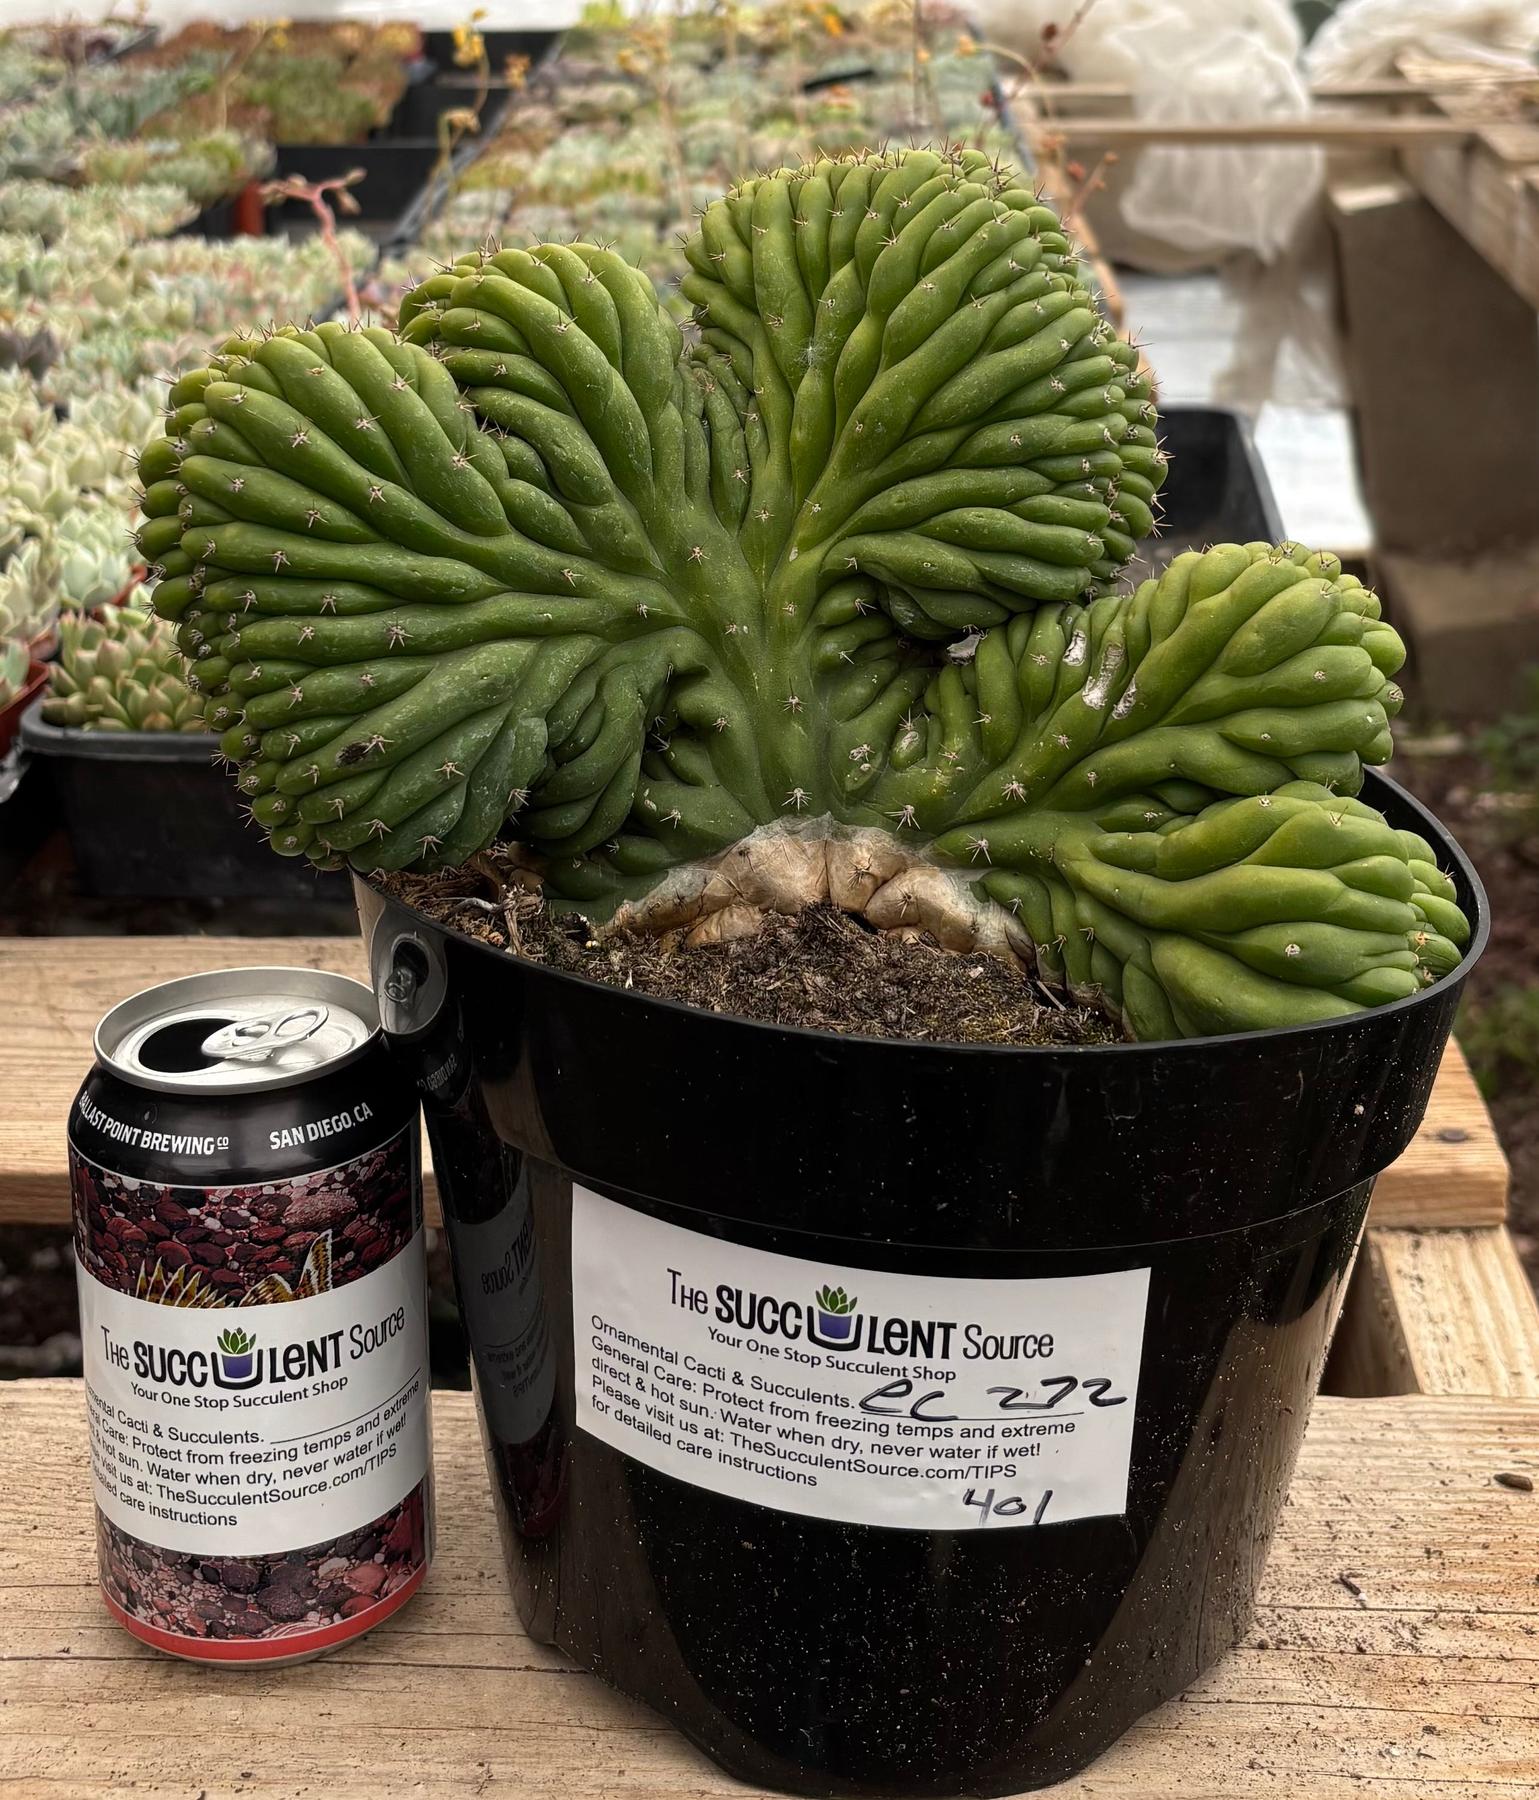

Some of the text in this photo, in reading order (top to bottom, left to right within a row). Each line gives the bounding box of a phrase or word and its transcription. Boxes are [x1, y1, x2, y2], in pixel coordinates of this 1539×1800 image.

[78, 1090, 108, 1133] BALLAST
[103, 1117, 141, 1147] POINT
[141, 1131, 215, 1156] BREWING
[269, 1125, 305, 1150] SAN
[354, 1102, 374, 1126] CA
[350, 1306, 406, 1360] Source
[591, 1315, 855, 1409] Ornamental Cacti & Succulents.
[708, 1326, 957, 1381] Your One Stop Succulent Shop
[963, 1324, 1054, 1360] Source
[131, 1376, 348, 1412] Your One Stop Succulent Shop
[591, 1335, 1076, 1441] General Care: Protect from freezing temps and extreme
[592, 1356, 1041, 1460] direct & hot sun. Water when dry, never water if wet!
[986, 1375, 1128, 1411] 272
[102, 1418, 129, 1447] Care:
[133, 1436, 182, 1463] Protect
[187, 1446, 223, 1465] from
[229, 1446, 298, 1467] freezing
[303, 1430, 351, 1457] temps
[355, 1416, 380, 1437] and
[383, 1380, 420, 1421] extreme
[102, 1435, 116, 1459] hot
[118, 1451, 143, 1473] sun.
[147, 1460, 191, 1485] Water
[195, 1471, 240, 1486] when
[247, 1470, 277, 1487] dry,
[283, 1459, 328, 1481] never
[333, 1440, 373, 1466] water
[376, 1431, 385, 1449] if
[386, 1413, 407, 1441] wet!
[118, 1410, 148, 1434] Cacti
[153, 1424, 163, 1438] &
[168, 1427, 265, 1445] Succulents.
[592, 1375, 1017, 1481] Please visit us at: TheSucculentSource.com/TIPS
[592, 1395, 818, 1487] for detailed care instructions
[101, 1455, 117, 1479] visit
[120, 1472, 133, 1487] us
[137, 1480, 152, 1495] at:
[156, 1443, 397, 1506] TheSucculentSource.com/TIPS
[120, 1492, 145, 1511] care
[149, 1501, 238, 1527] instructions
[963, 1487, 1053, 1526] 401
